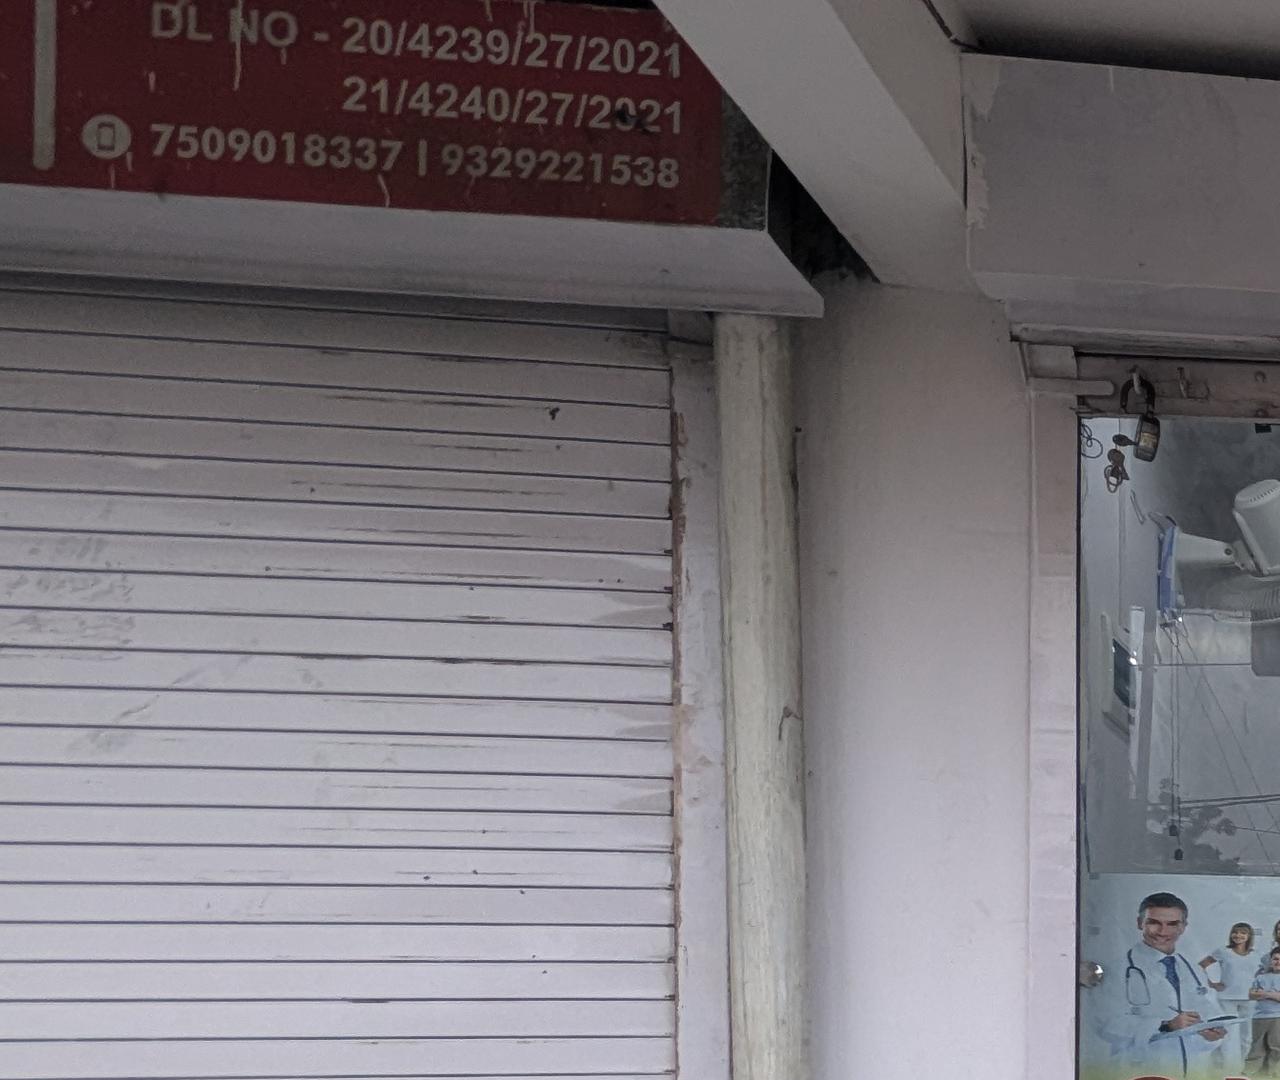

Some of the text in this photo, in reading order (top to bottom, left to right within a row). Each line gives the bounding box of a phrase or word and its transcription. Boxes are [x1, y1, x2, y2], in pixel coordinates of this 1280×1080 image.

[151, 0, 685, 78] DL NO 20/4239/27/2021
[342, 76, 681, 134] 21/4240/27/2021
[150, 124, 679, 188] 7509018337 9329221538
